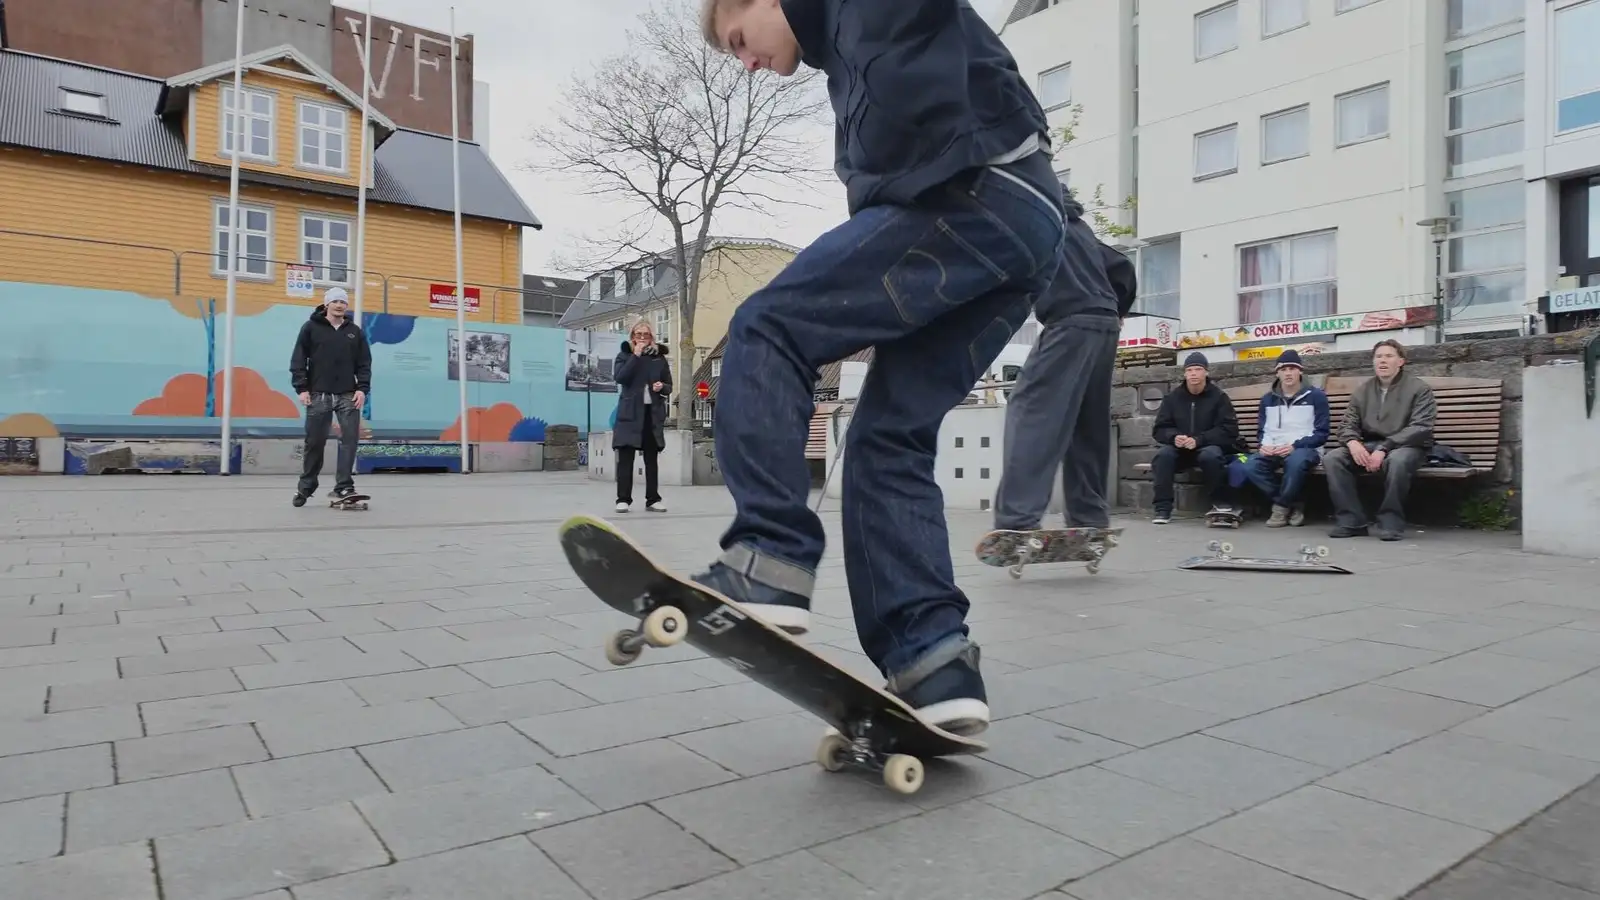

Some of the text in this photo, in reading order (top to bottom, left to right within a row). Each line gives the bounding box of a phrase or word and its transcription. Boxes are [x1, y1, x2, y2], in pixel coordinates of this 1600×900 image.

[1254, 317, 1353, 337] CORNER MARKET
[1247, 350, 1265, 359] ATM
